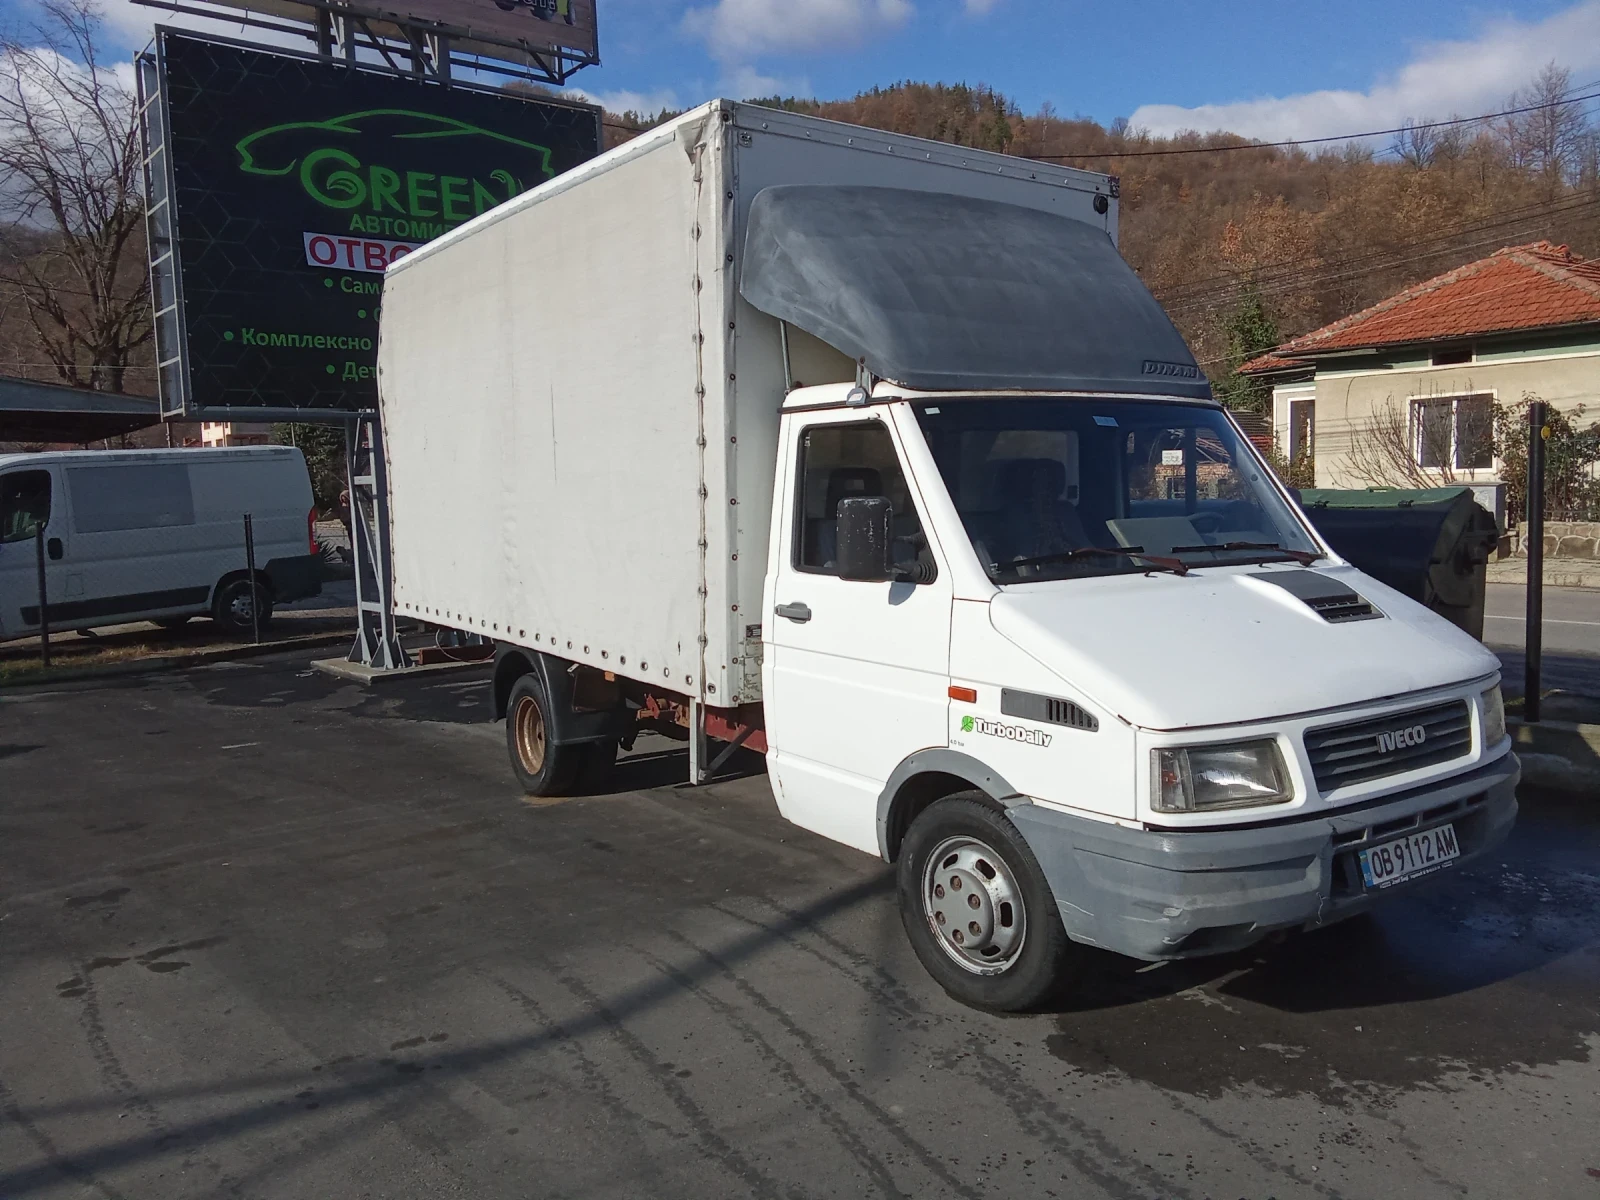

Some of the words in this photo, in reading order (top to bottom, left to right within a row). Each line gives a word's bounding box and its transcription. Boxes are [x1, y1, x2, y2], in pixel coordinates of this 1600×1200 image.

[301, 148, 517, 221] GREEN
[340, 276, 382, 295] Сам
[241, 327, 372, 351] Комплексно
[974, 716, 1053, 748] TurboDaily
[1378, 725, 1426, 753] IVECO
